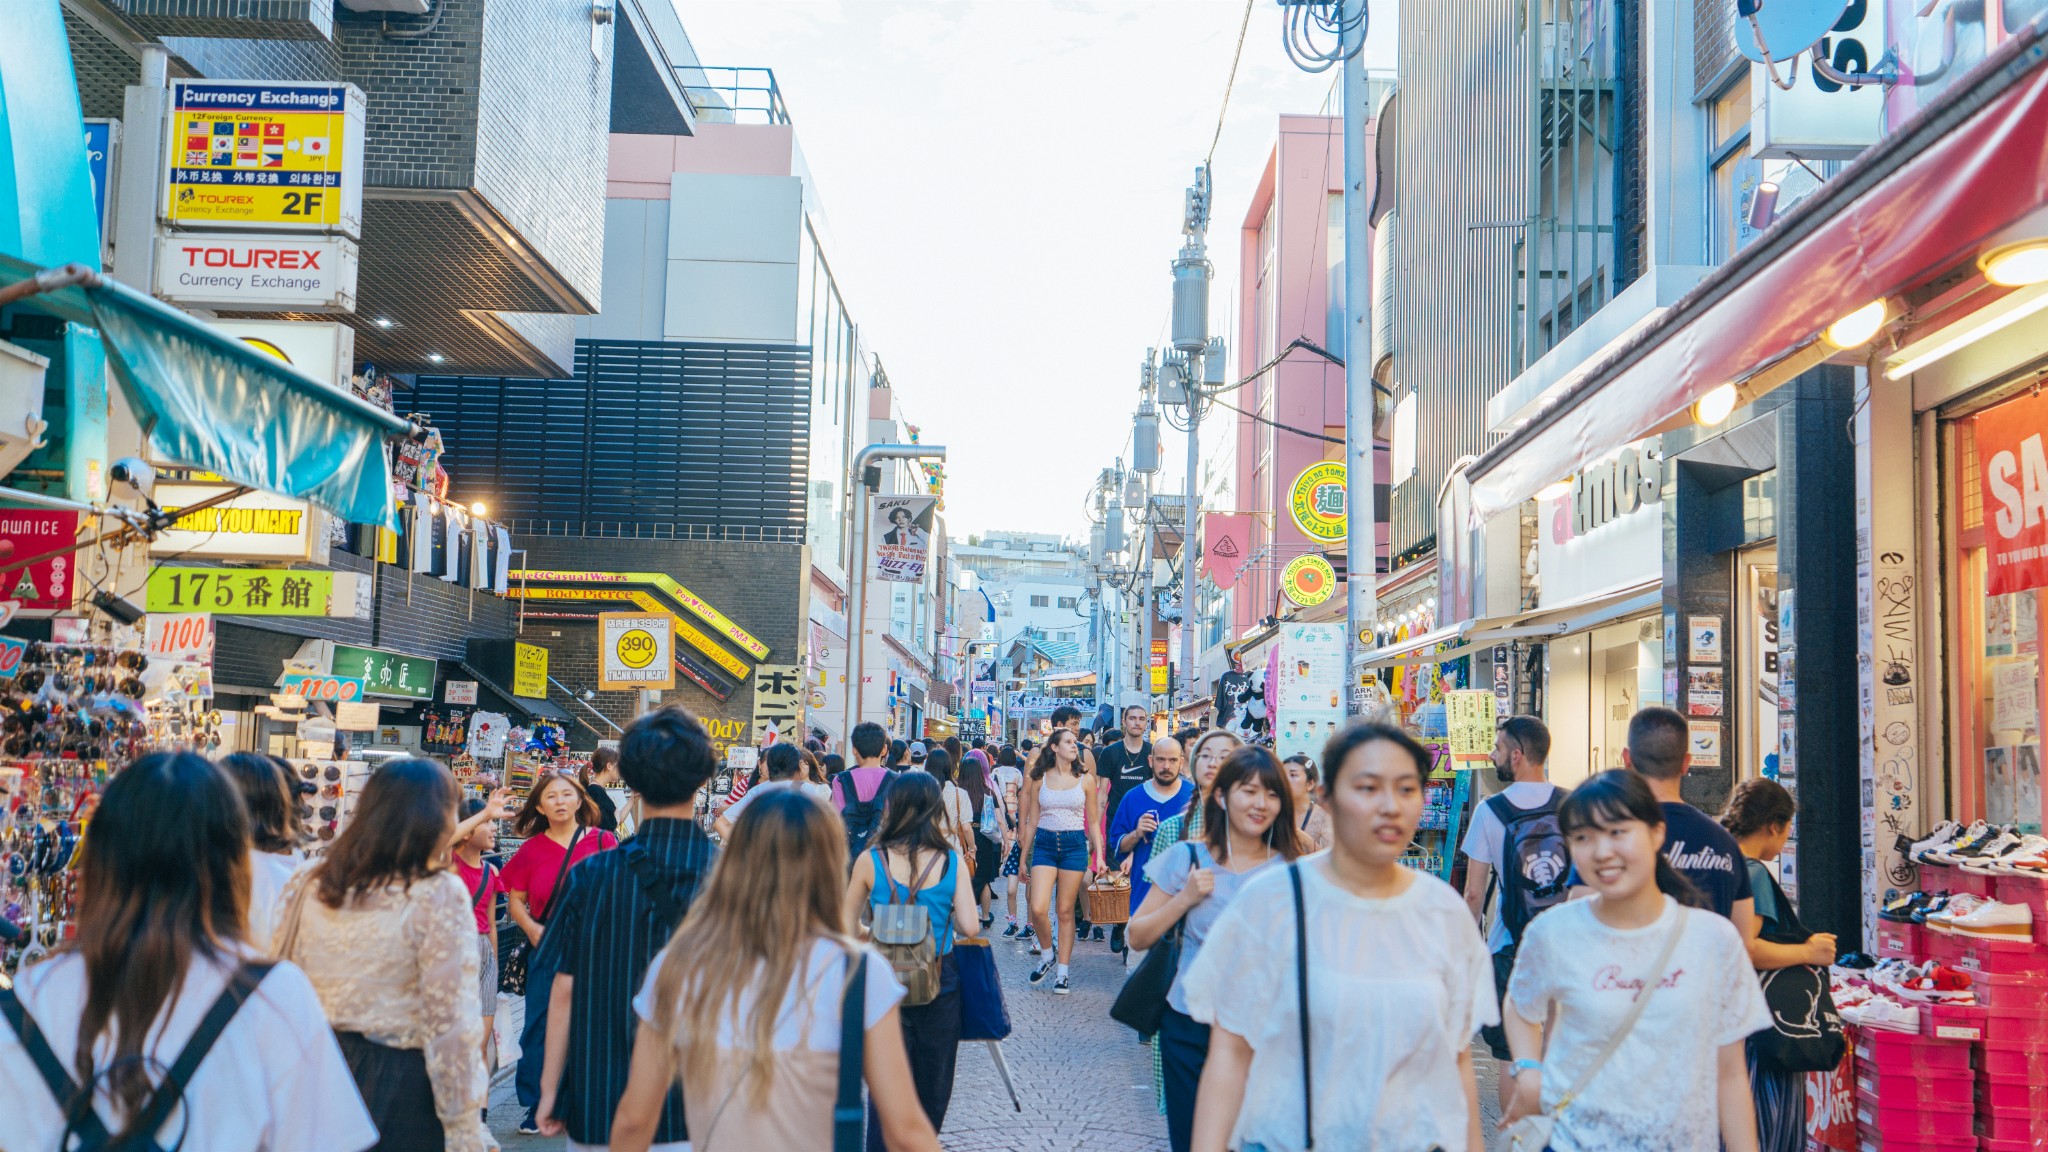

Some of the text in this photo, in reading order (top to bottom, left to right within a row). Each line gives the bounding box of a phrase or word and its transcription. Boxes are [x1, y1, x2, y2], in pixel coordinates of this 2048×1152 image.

[182, 89, 339, 107] Currency Exchange
[192, 113, 274, 122] 12Foreign Currency
[308, 155, 323, 163] JPY
[177, 206, 254, 216] Currency Exchange
[198, 192, 323, 216] TOUREX 2F
[182, 247, 321, 270] TOUREX
[179, 273, 321, 291] Currency Exchange
[1297, 477, 1315, 495] Taiyo
[1313, 470, 1323, 480] no
[1552, 435, 1662, 546] atmos
[878, 499, 911, 509] SAKU
[219, 508, 253, 533] YOU
[253, 510, 303, 534] MART
[168, 573, 313, 609] 175番館
[582, 590, 634, 600] Pierce
[675, 588, 765, 654] Pop Cute PMA 2F
[621, 636, 653, 651] 390
[607, 670, 667, 681] THANK YOU MART
[284, 678, 358, 700] ¥1100
[1354, 687, 1372, 695] ARK
[452, 760, 474, 768] MAGNET
[570, 752, 592, 761] MAGNE
[1663, 840, 1734, 872] llantine's
[1831, 1090, 1855, 1127] OFF
